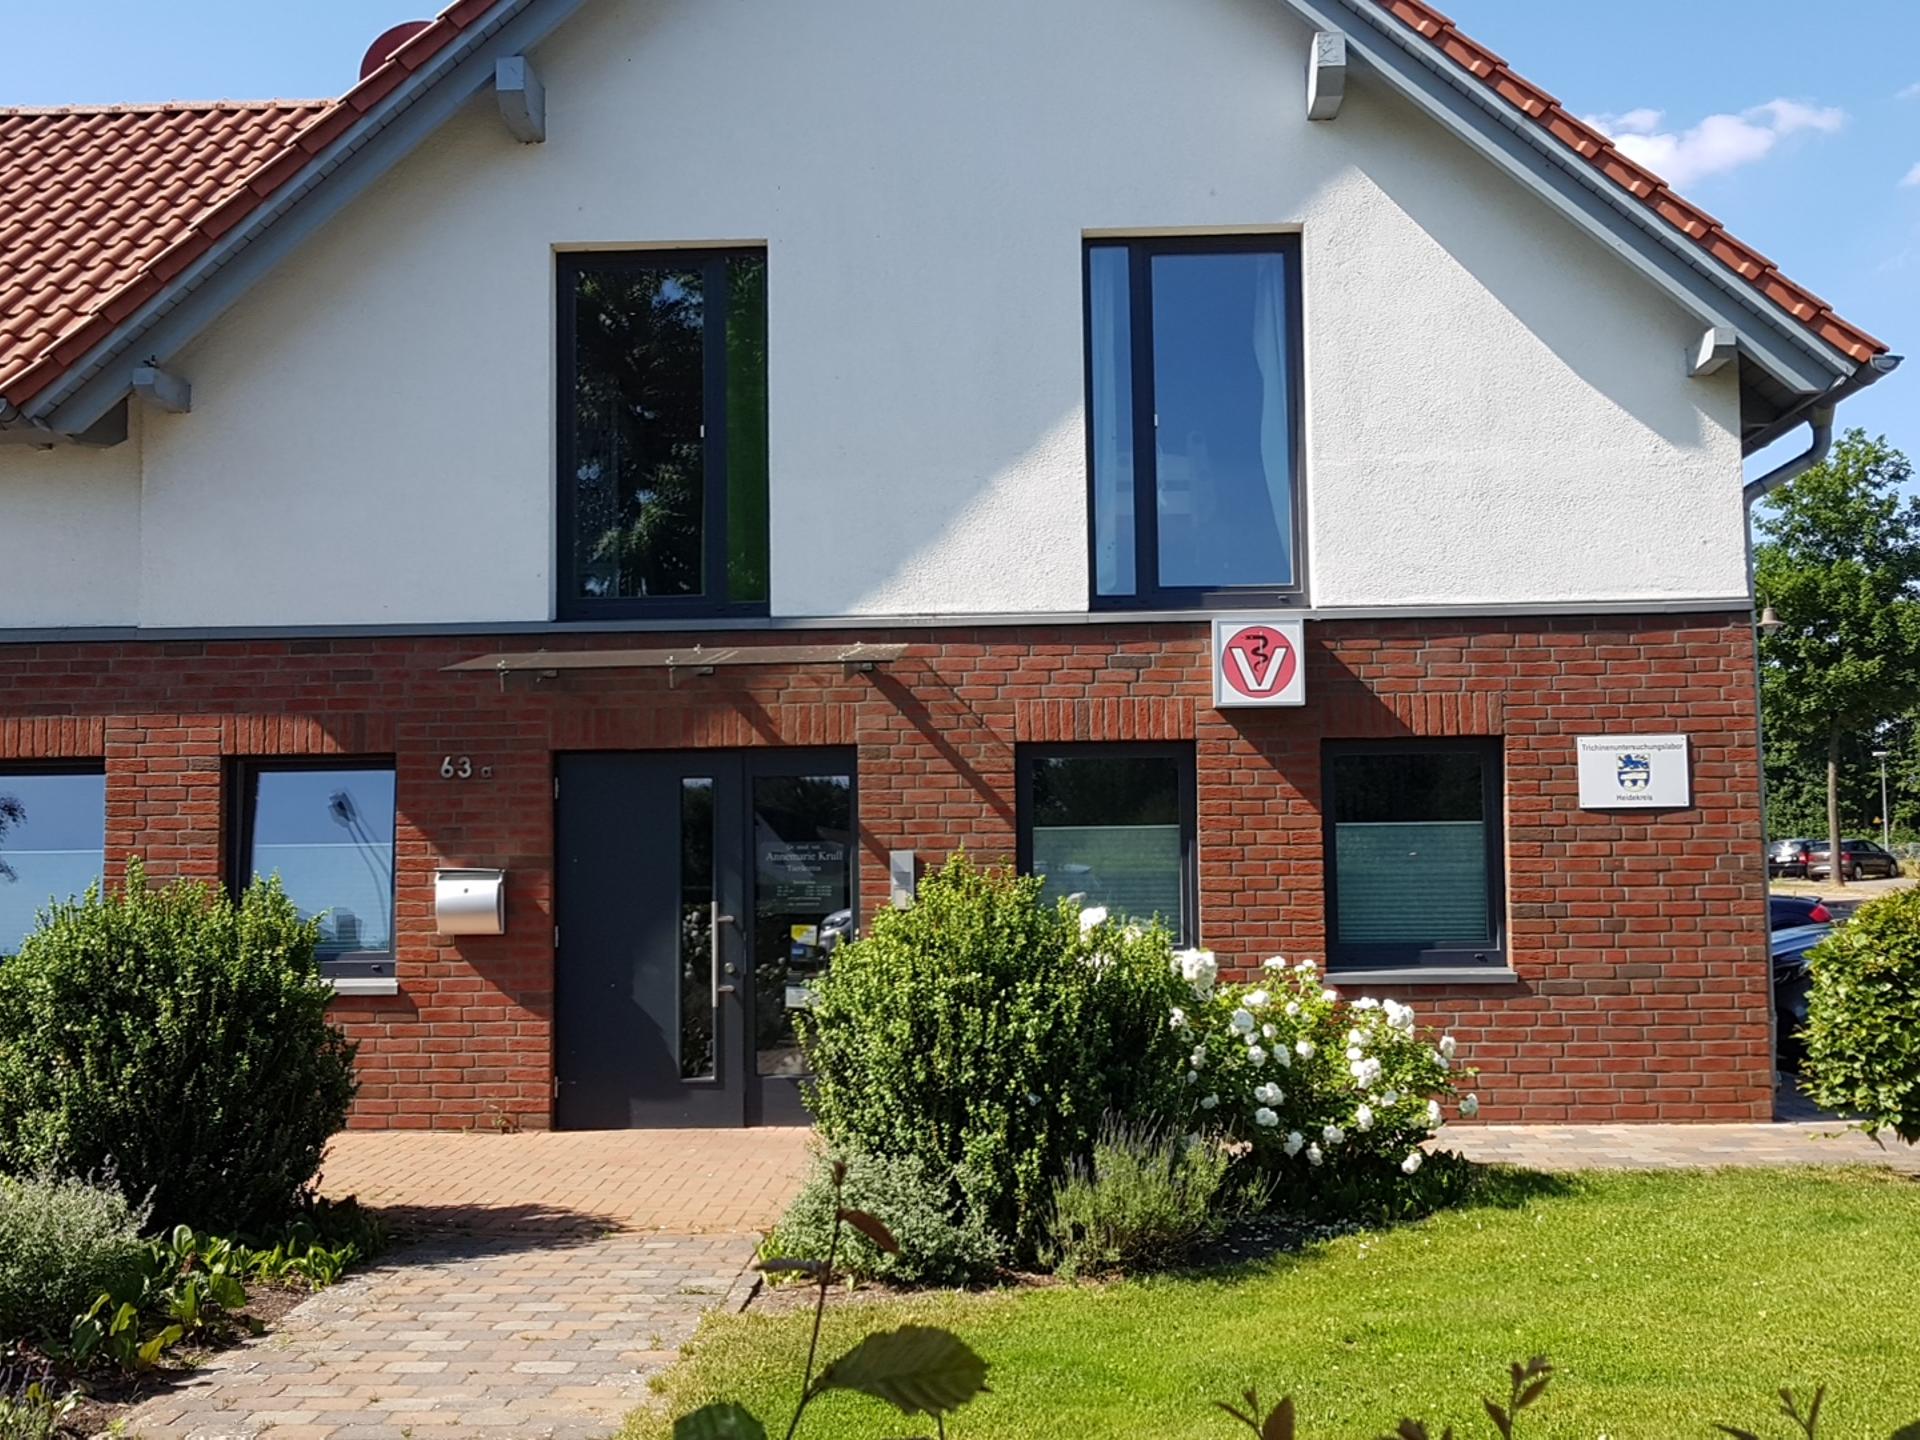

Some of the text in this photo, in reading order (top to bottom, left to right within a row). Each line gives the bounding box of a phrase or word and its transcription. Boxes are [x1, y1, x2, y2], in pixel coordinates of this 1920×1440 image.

[1582, 743, 1683, 752] Trichinenuntersuchungslabor
[440, 756, 492, 778] 63 a
[1616, 793, 1653, 801] Heidekreis
